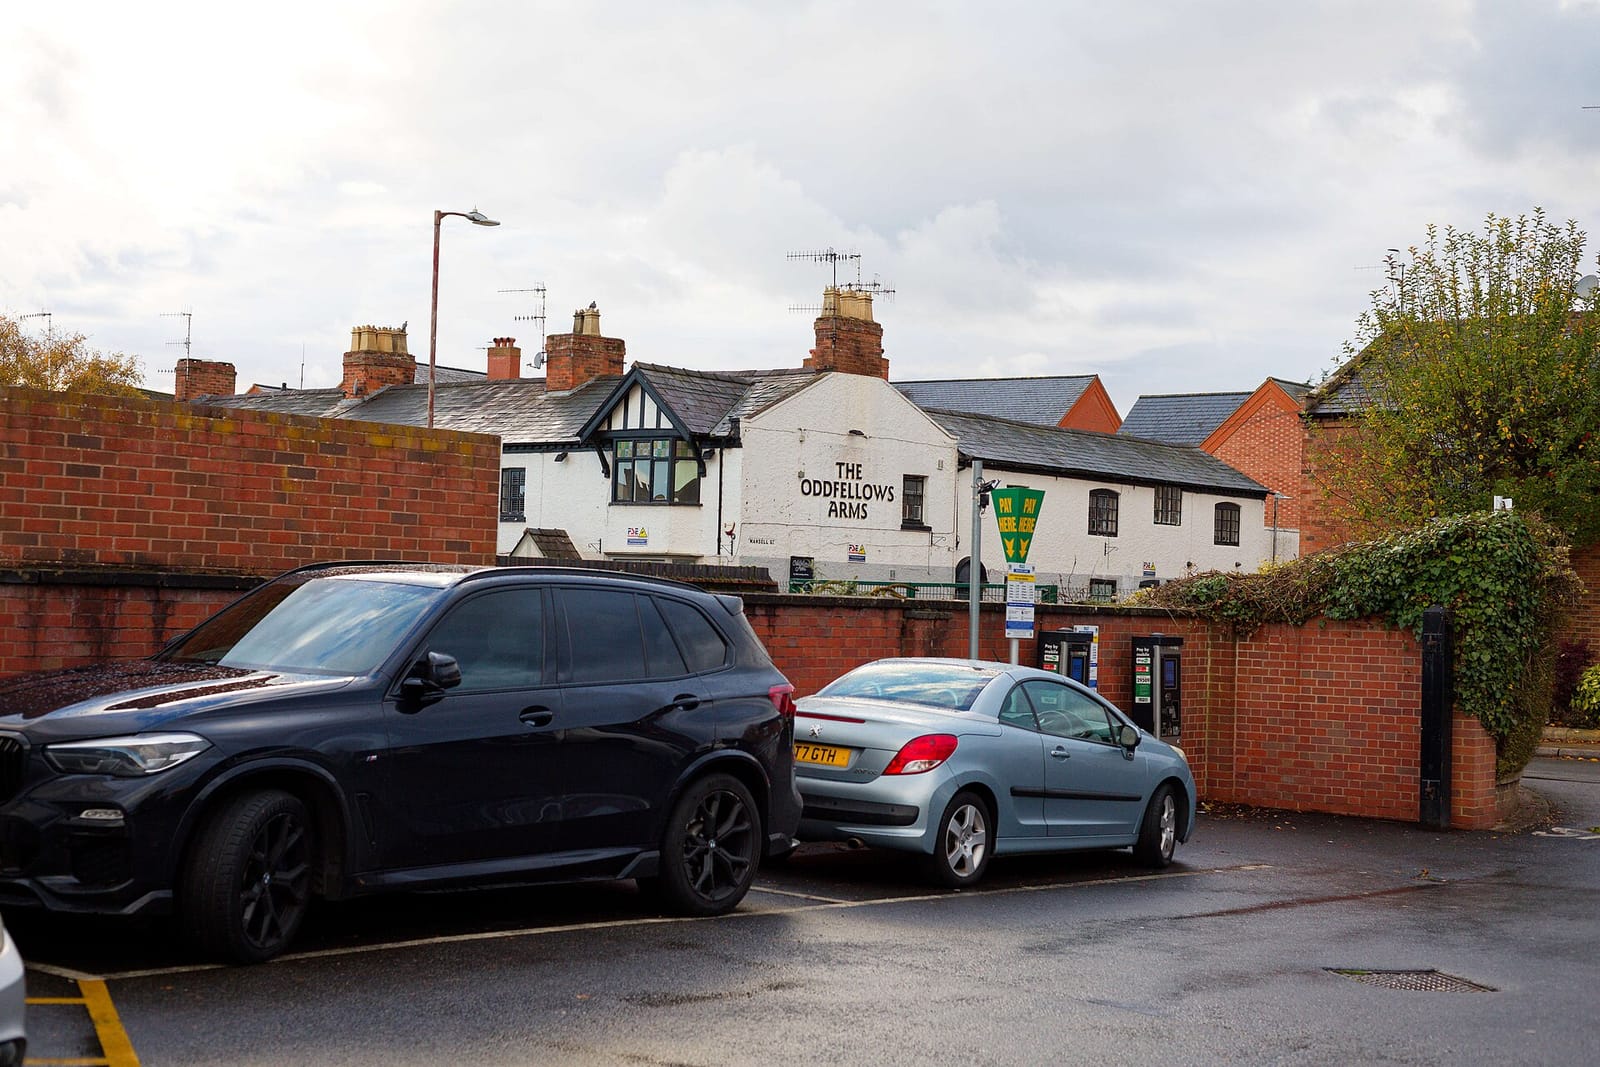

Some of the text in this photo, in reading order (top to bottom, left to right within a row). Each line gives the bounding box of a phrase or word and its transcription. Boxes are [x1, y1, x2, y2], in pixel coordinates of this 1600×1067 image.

[835, 462, 862, 480] THE
[801, 479, 894, 502] ODDFELLOWS
[828, 501, 868, 520] ARMS
[999, 497, 1012, 513] PAY
[1023, 498, 1036, 514] PAY
[998, 516, 1017, 532] HERE
[1018, 516, 1035, 533] HERE
[811, 747, 837, 763] GTH
